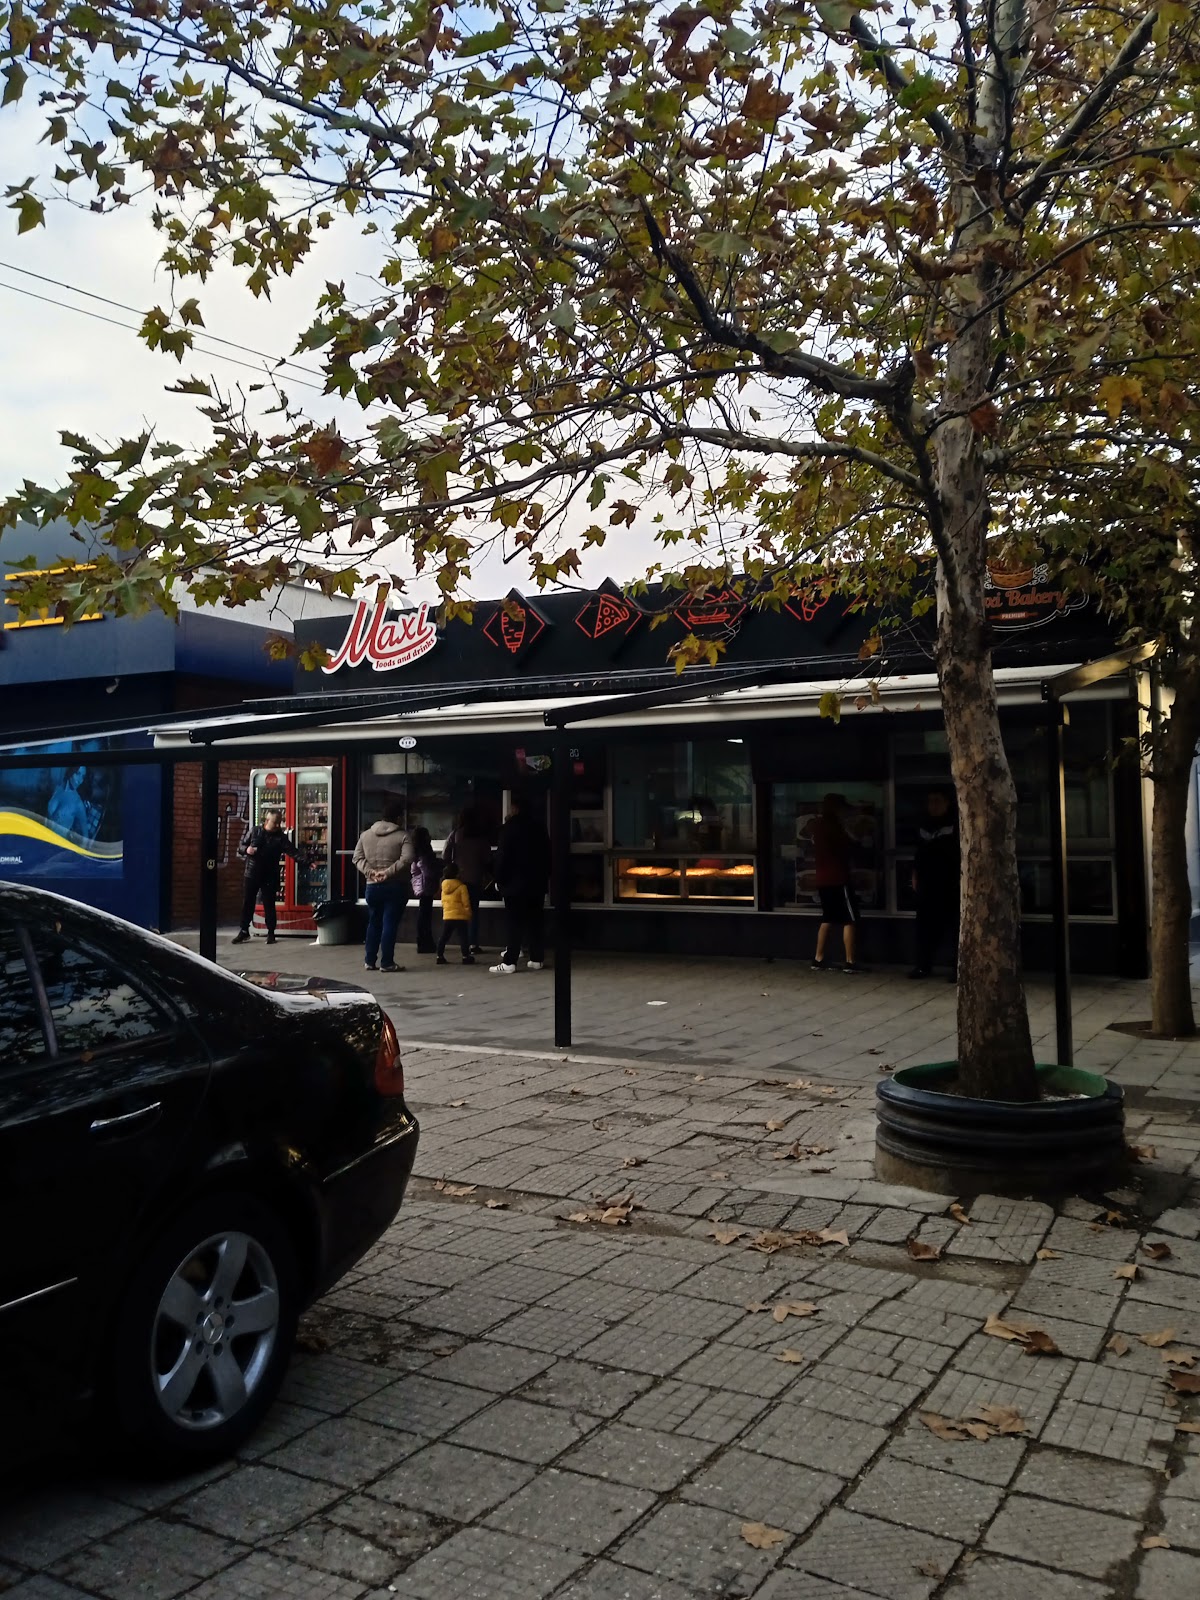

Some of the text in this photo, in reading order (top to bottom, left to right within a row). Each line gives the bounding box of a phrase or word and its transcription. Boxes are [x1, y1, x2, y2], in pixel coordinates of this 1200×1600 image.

[1005, 587, 1064, 609] Bakery
[324, 583, 434, 669] Maxi
[376, 638, 435, 669] foods and drinks
